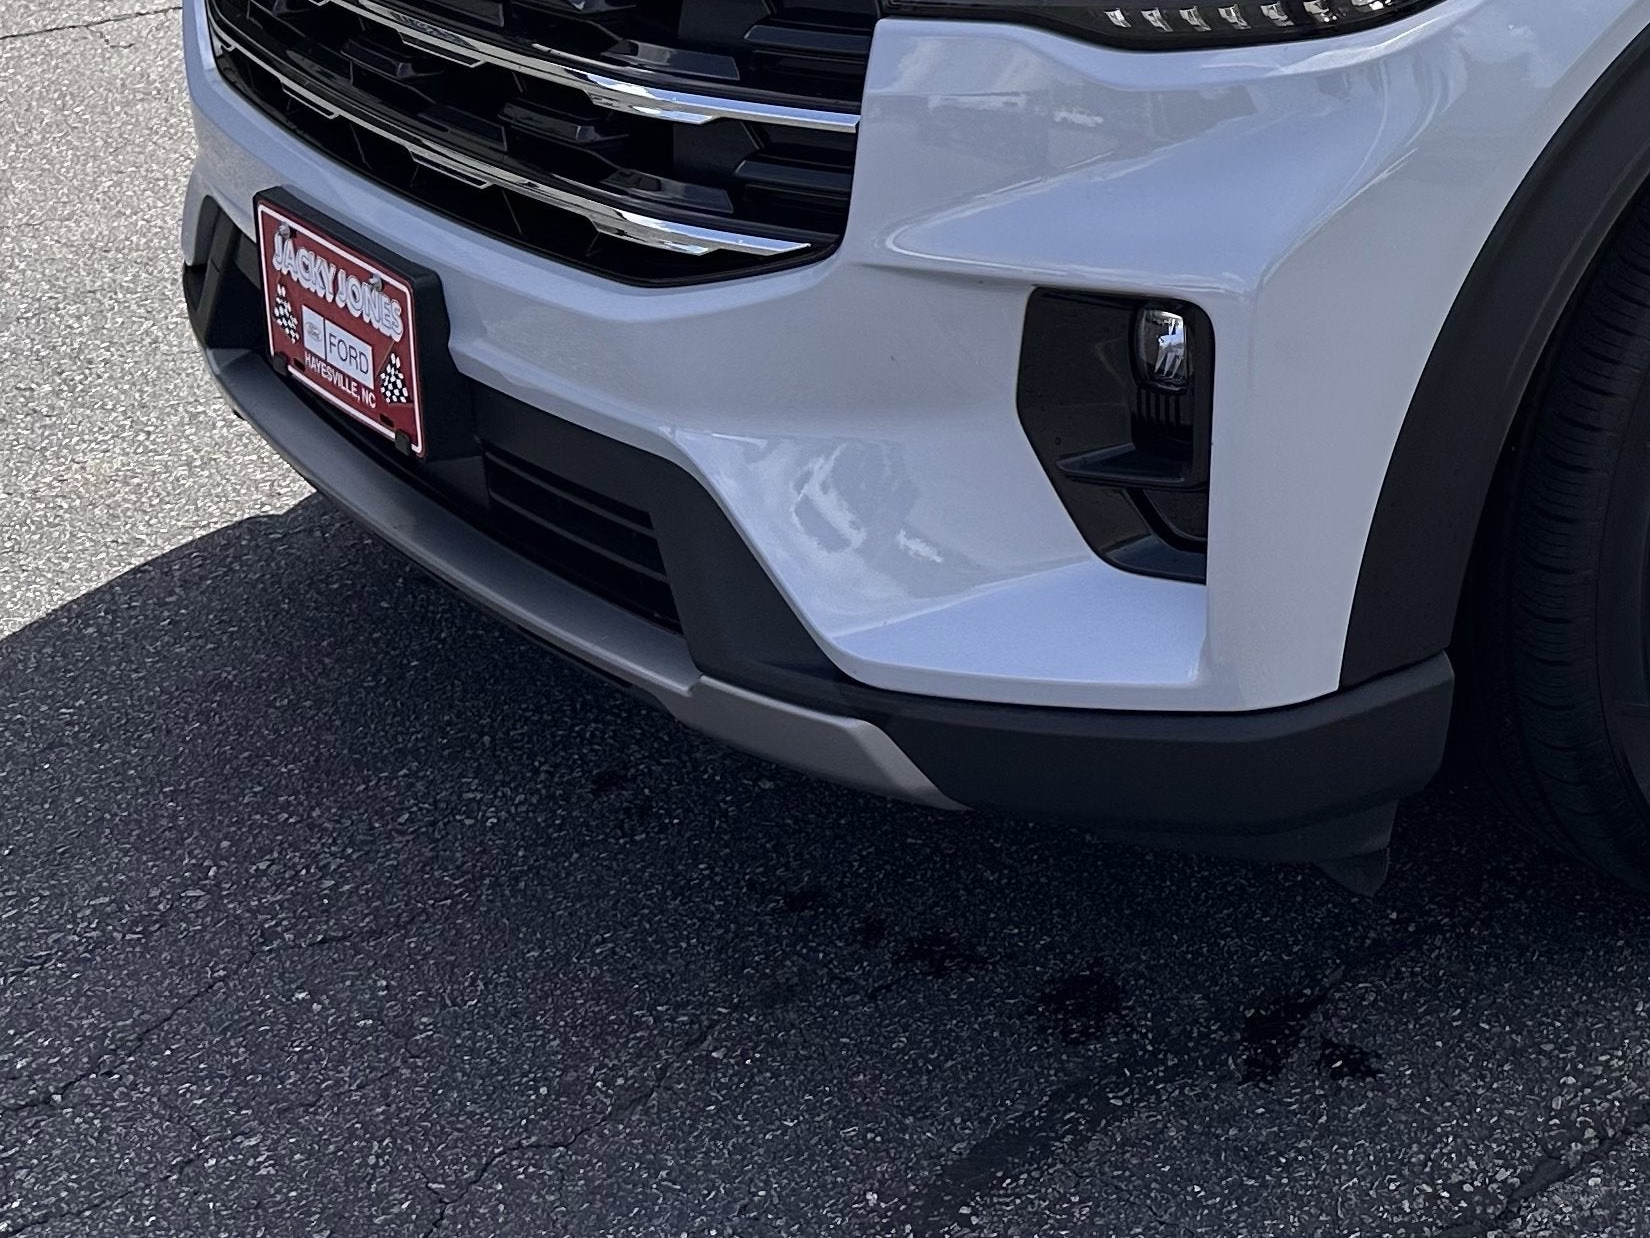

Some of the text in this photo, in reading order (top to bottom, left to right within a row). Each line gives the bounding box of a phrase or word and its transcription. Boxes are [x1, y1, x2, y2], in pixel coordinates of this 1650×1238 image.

[273, 230, 404, 342] JACKY JONES
[304, 350, 377, 409] HAYESVILLE, NC
[329, 332, 369, 374] FORD
